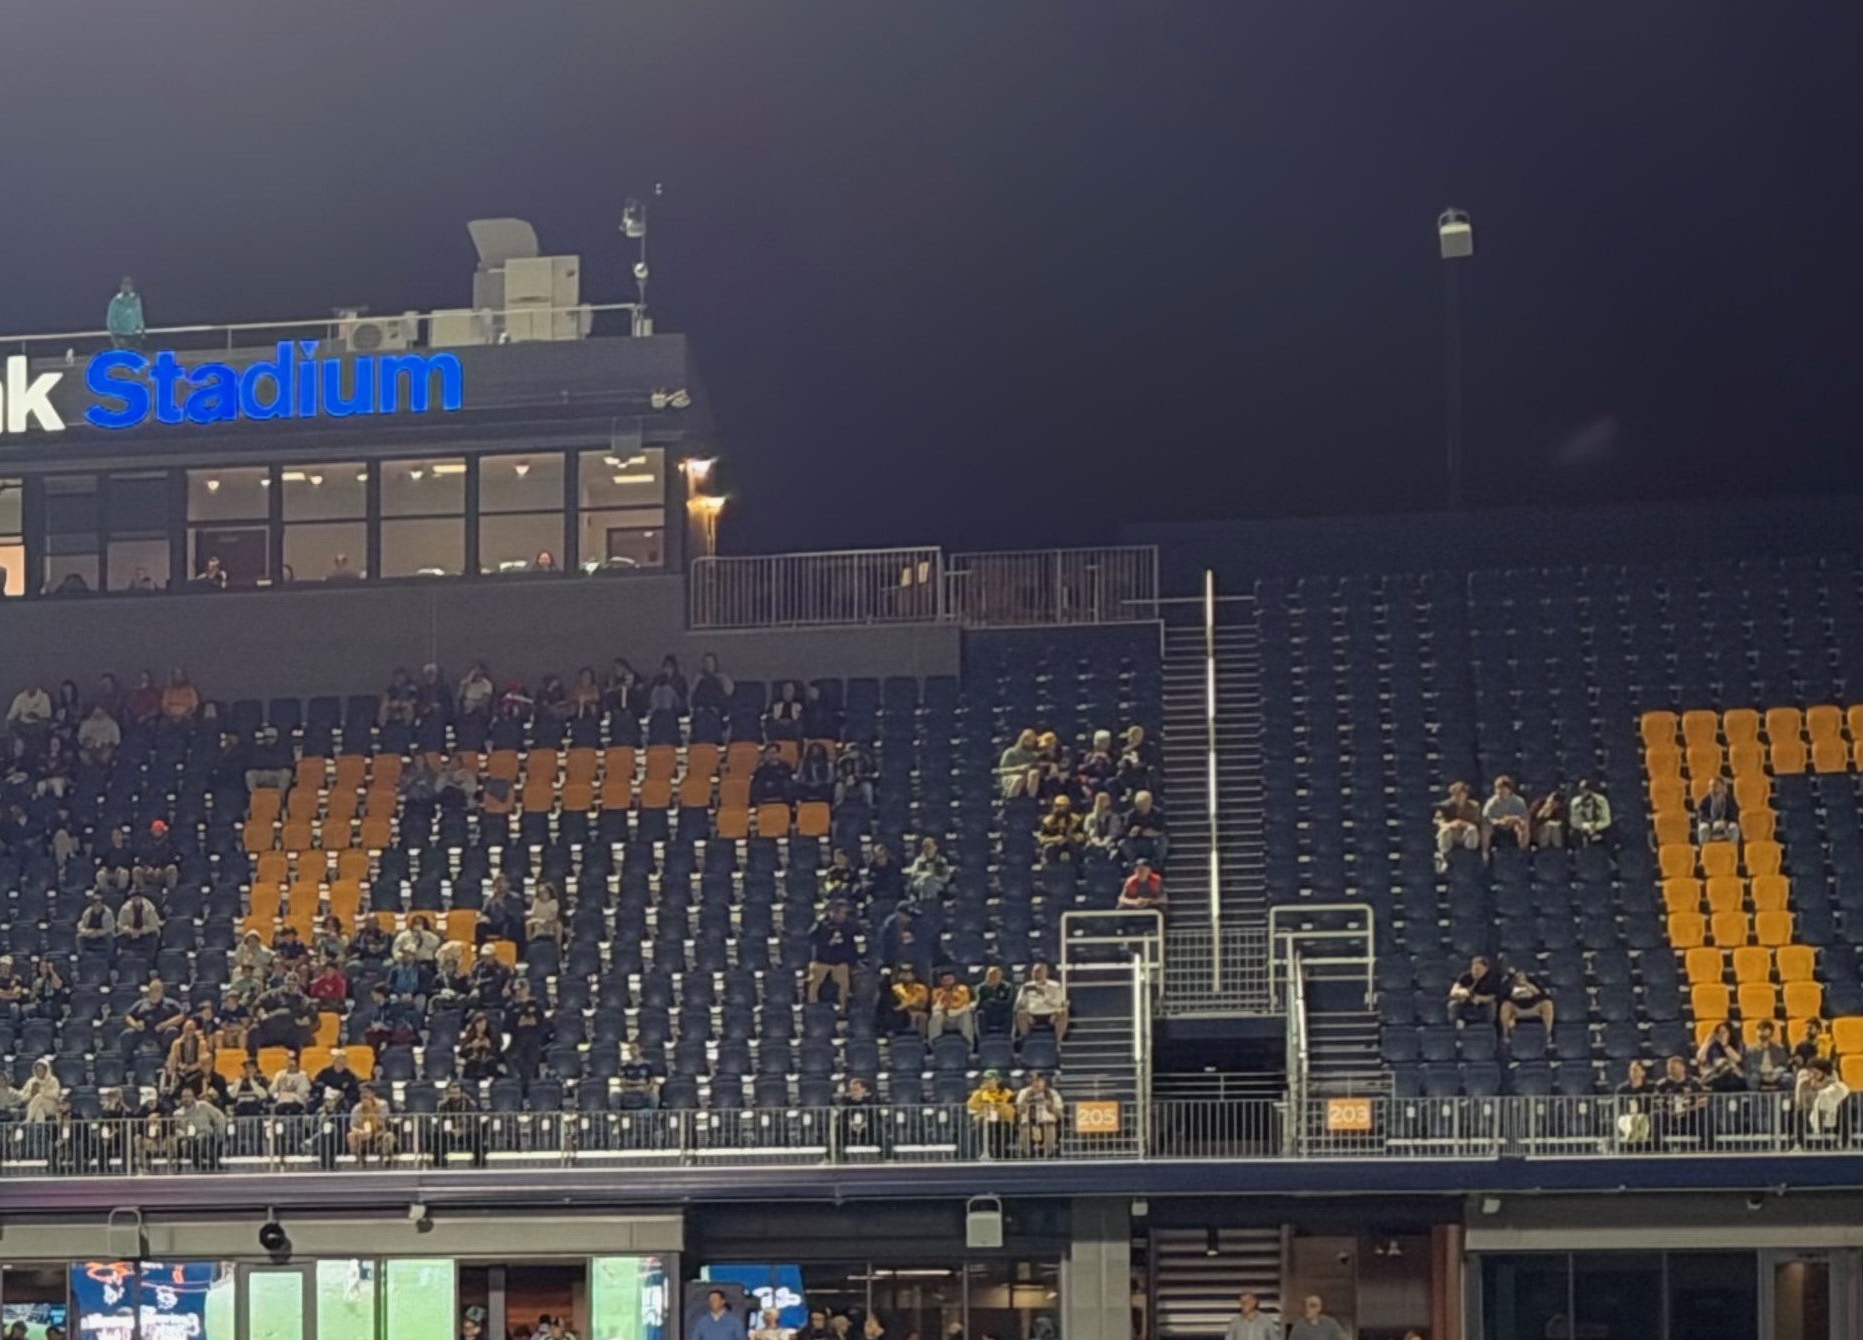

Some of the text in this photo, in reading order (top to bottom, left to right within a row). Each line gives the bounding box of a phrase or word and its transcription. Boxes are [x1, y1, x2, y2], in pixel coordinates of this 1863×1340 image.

[84, 340, 463, 429] Stadium
[1078, 1108, 1117, 1125] 205
[1329, 1105, 1367, 1123] 203
